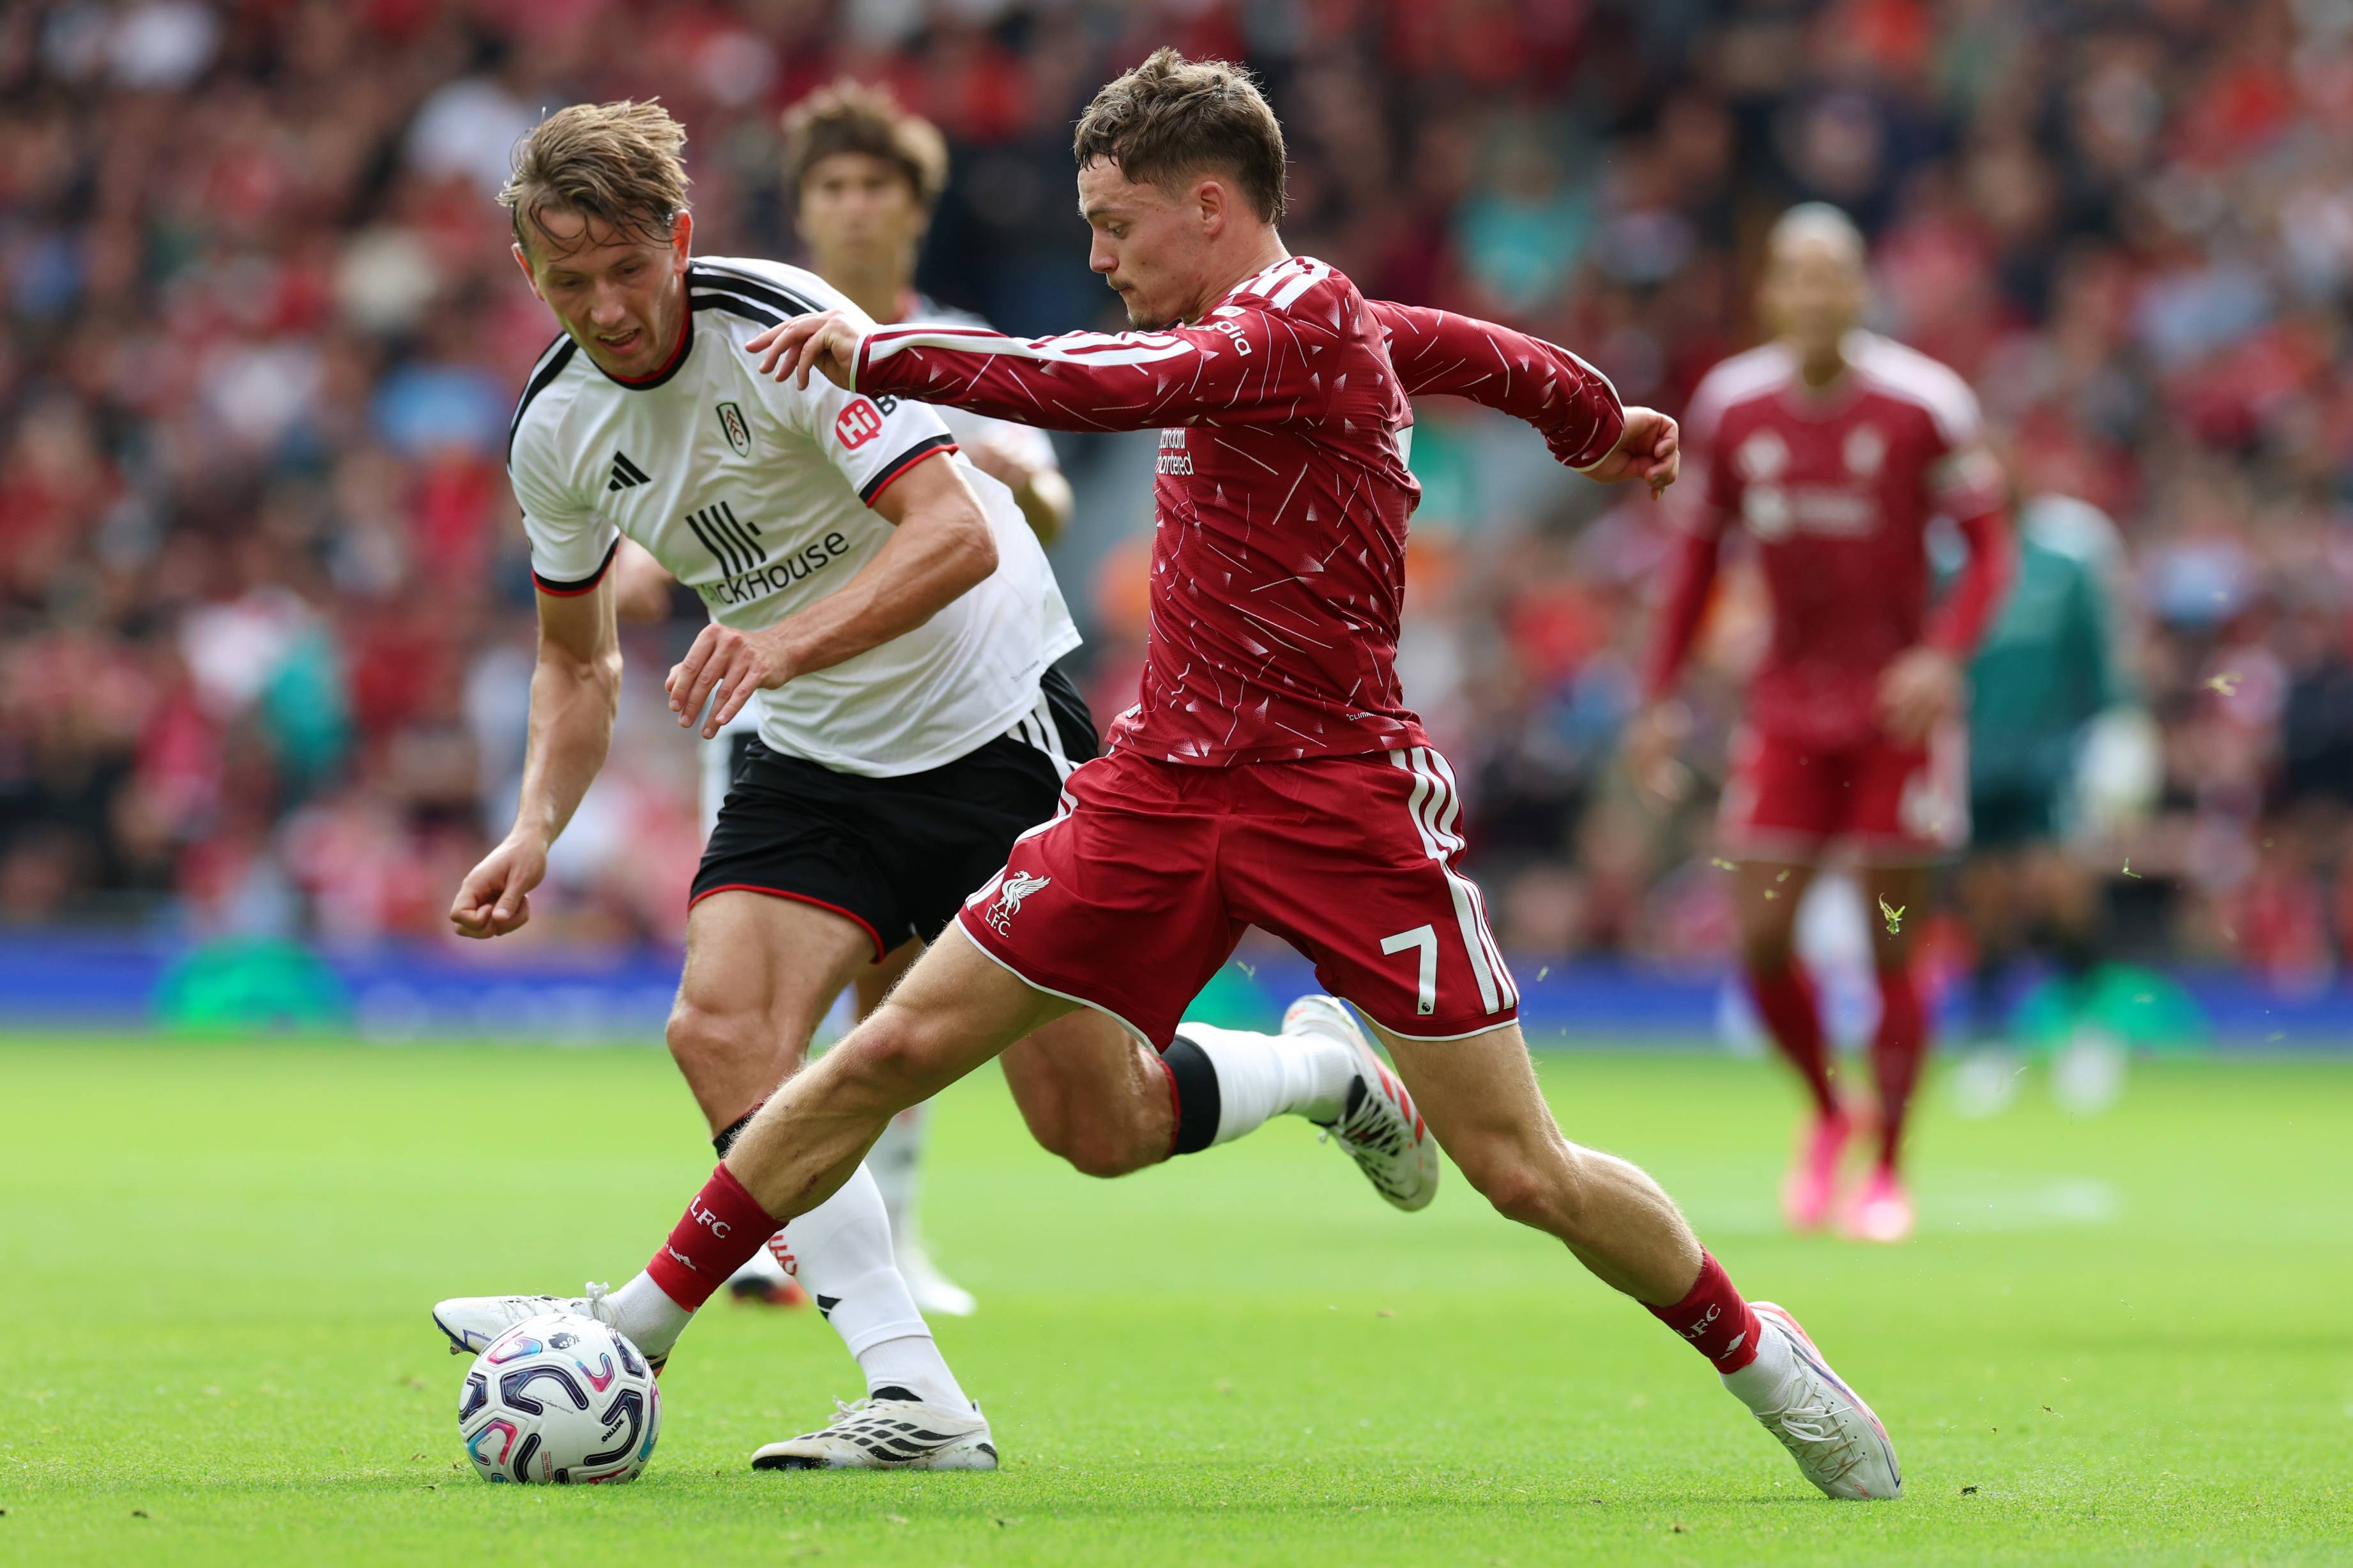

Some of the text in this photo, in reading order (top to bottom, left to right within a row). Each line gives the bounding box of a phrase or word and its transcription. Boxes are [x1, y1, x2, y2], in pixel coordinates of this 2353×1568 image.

[837, 405, 877, 445] Hi
[1159, 426, 1185, 449] tandard
[702, 532, 849, 605] ckHouse
[1380, 924, 1438, 1016] 7
[690, 1195, 731, 1239] LFC
[1675, 1303, 1721, 1339] LFC
[602, 1418, 626, 1442] NITRO
